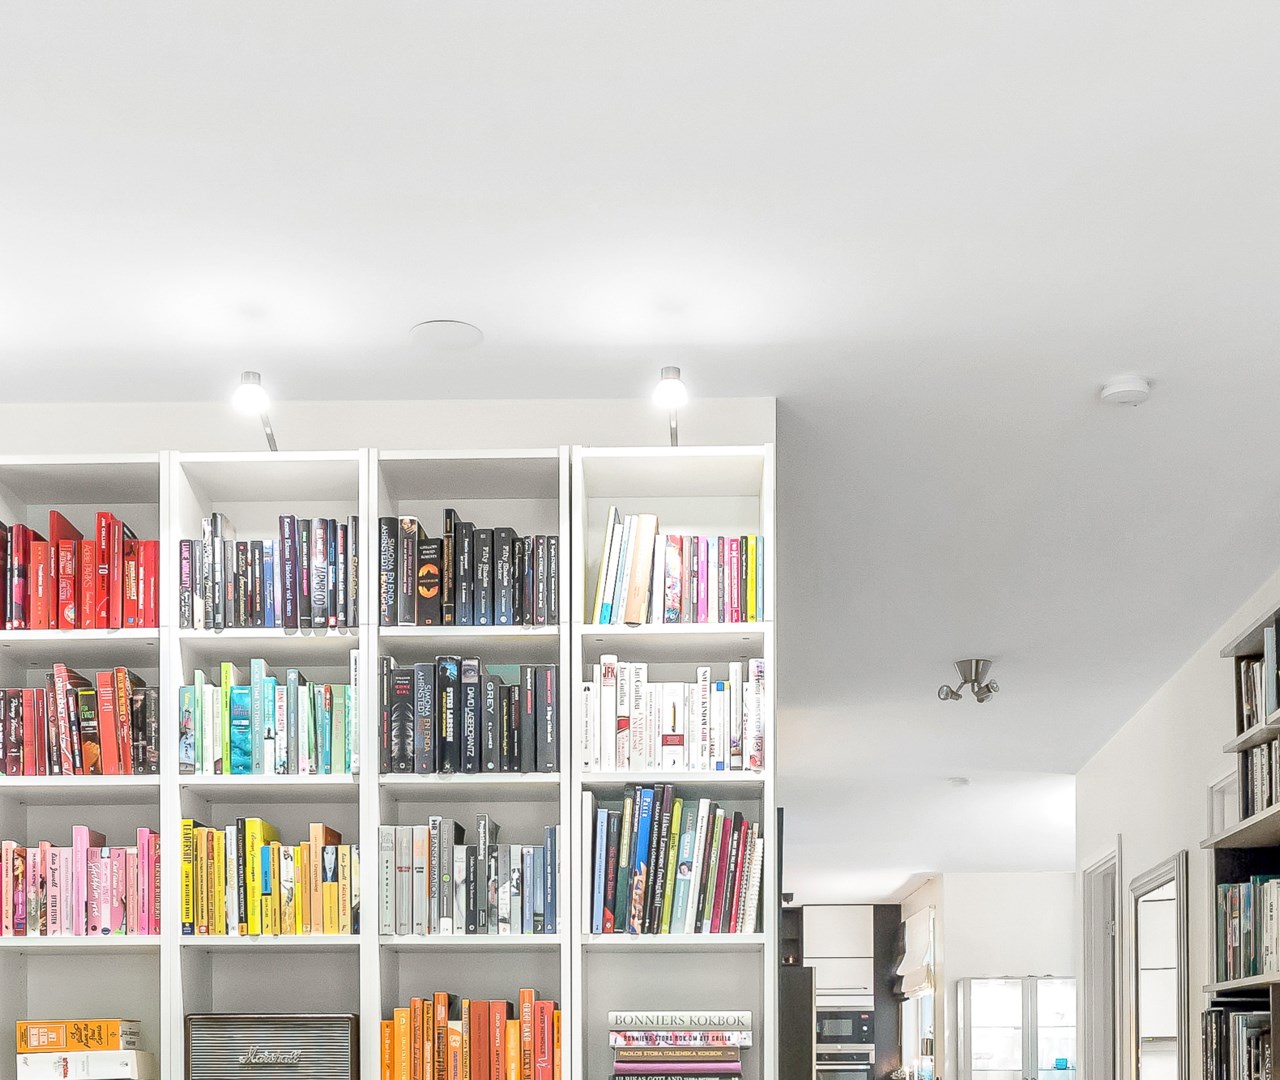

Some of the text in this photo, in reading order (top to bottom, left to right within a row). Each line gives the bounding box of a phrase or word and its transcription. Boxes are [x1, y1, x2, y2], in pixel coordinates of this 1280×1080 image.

[84, 564, 92, 587] PARKS
[388, 572, 394, 582] EN
[619, 666, 627, 678] Jan
[634, 666, 643, 709] Jan Guillou
[254, 700, 259, 709] TO
[424, 718, 431, 728] EN
[431, 820, 437, 830] HR
[183, 825, 192, 864] LEADERSHIP
[615, 1015, 745, 1026] BONNIERS KOKBOK
[523, 1049, 531, 1072] LUCKY
